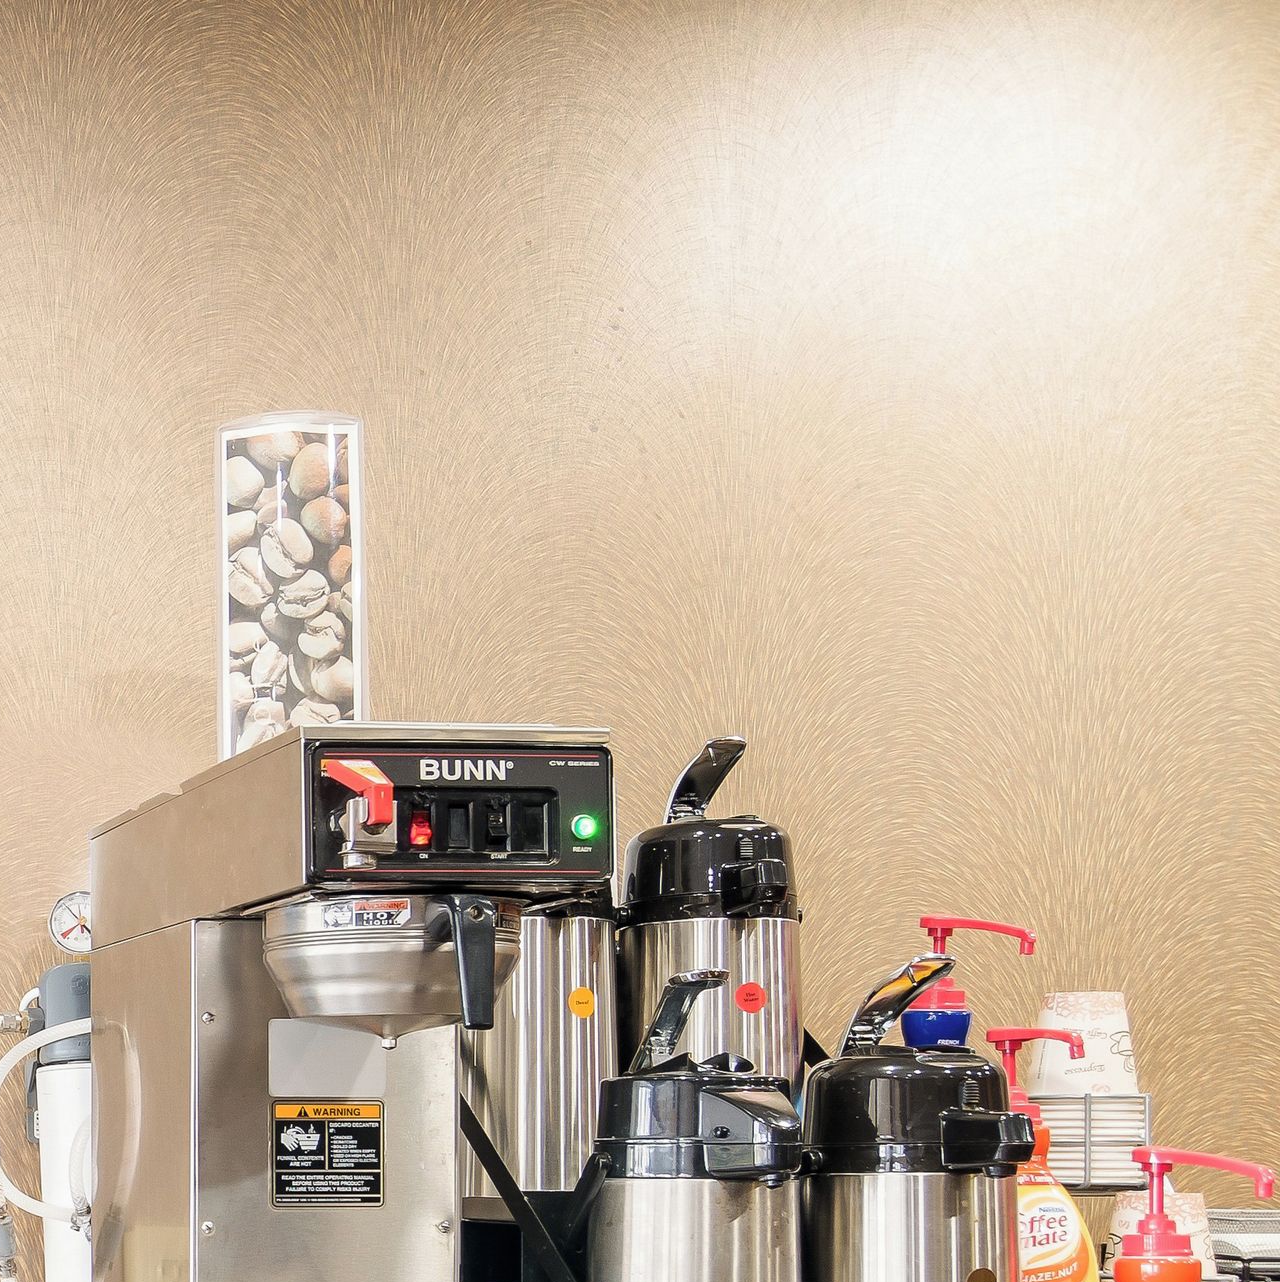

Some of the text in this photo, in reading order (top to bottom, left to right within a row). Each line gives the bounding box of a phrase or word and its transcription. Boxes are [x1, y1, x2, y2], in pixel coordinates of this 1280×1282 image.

[419, 759, 507, 781] BUNN
[312, 1108, 361, 1117] WARNING
[1019, 1214, 1068, 1235] offee
